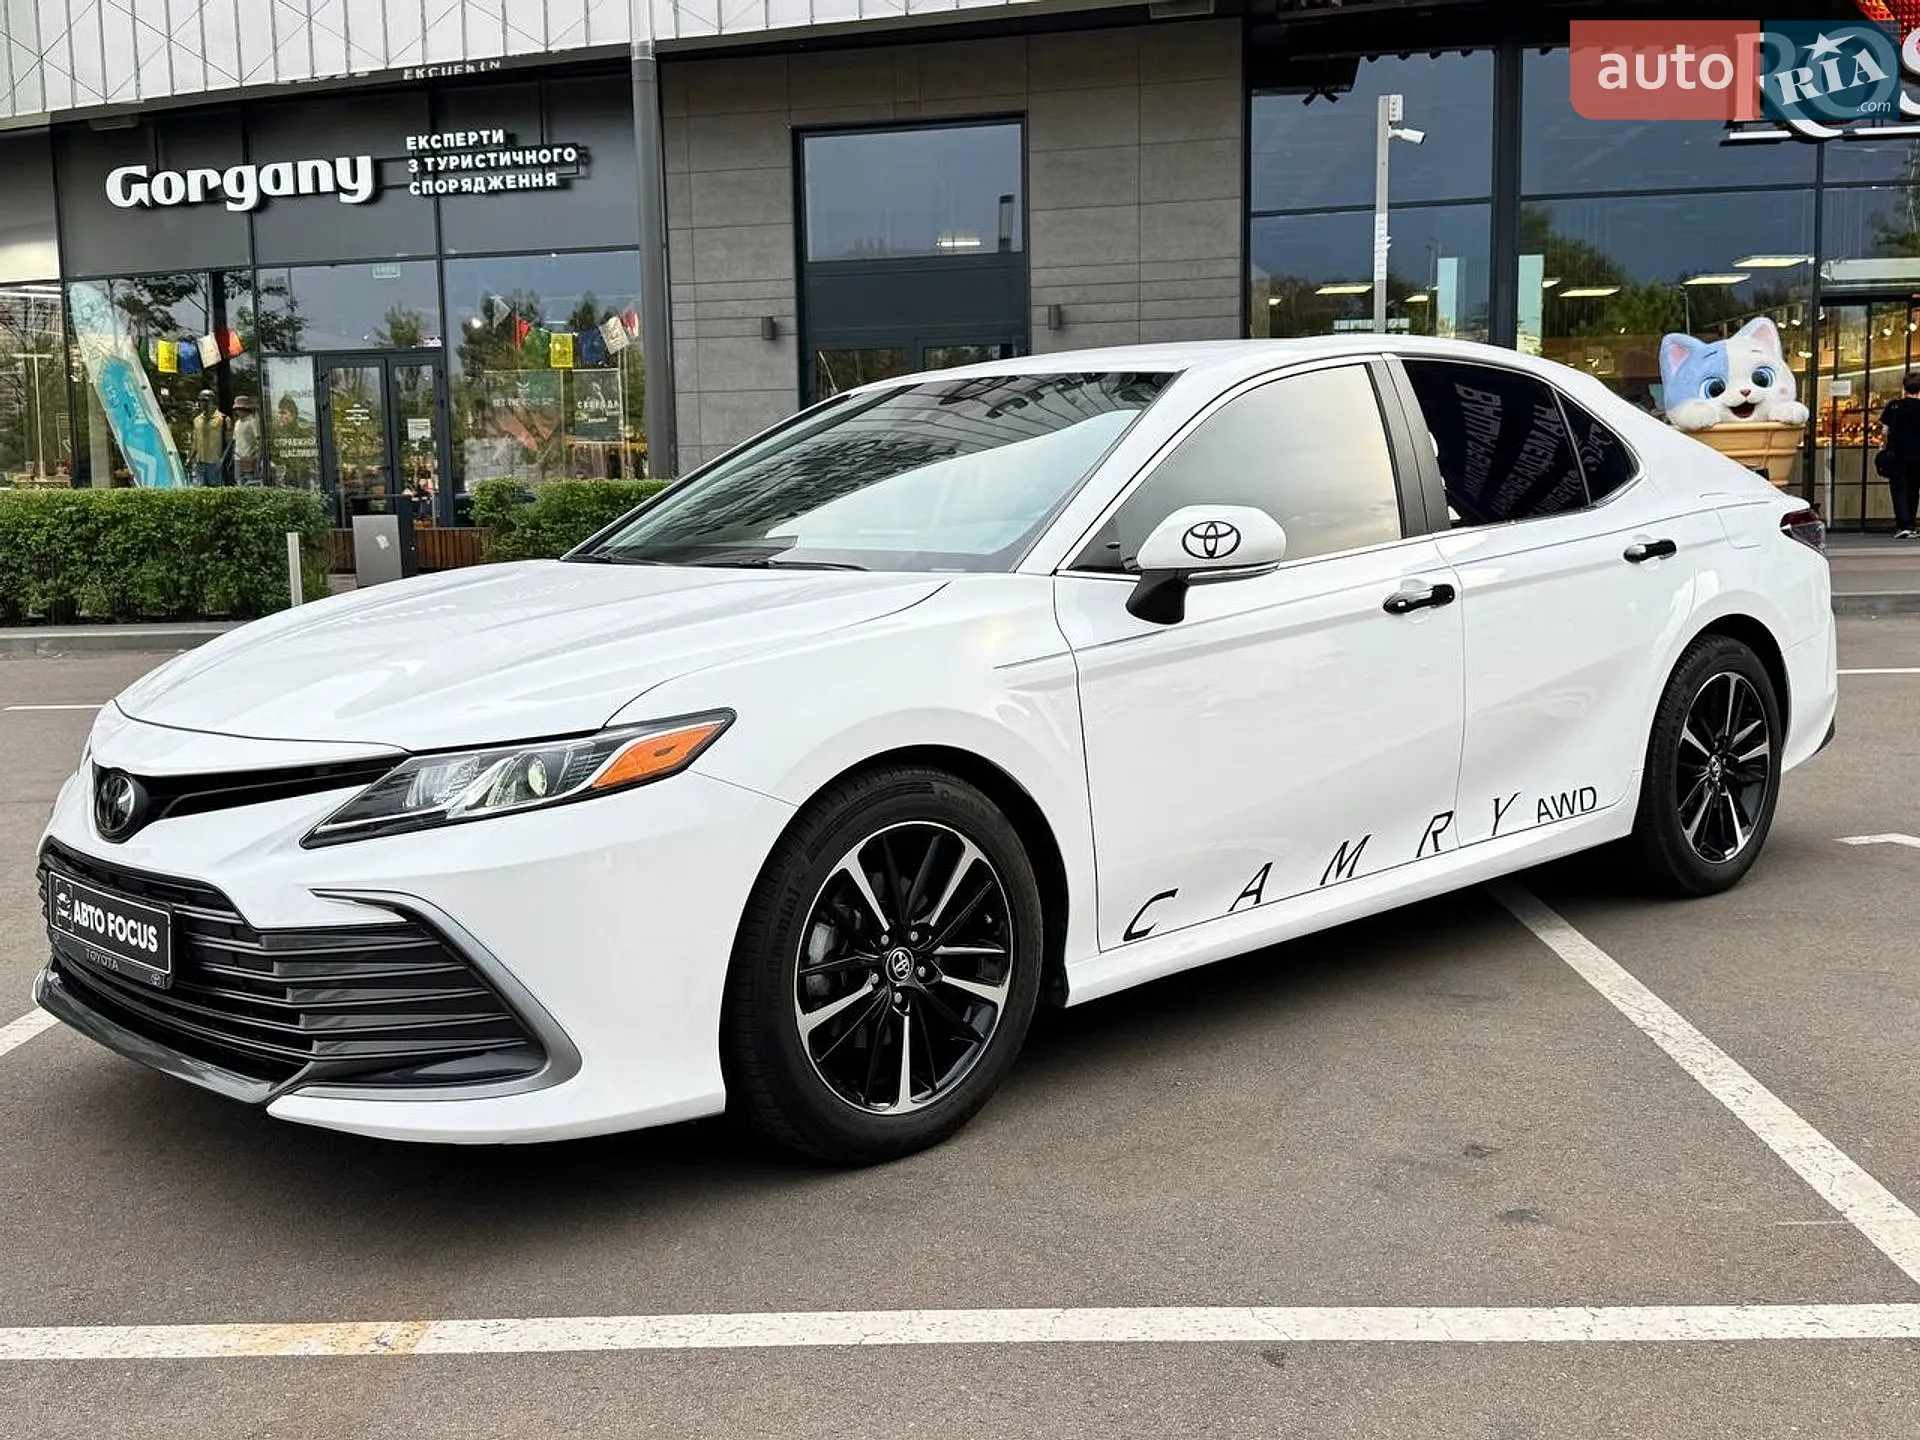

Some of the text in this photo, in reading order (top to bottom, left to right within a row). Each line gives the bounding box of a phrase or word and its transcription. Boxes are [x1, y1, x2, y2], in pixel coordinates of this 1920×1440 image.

[406, 129, 504, 150] ЕКСПЕРТИ
[424, 147, 577, 172] ТУРИСТИЧНОГО
[106, 155, 372, 212] Gorgany
[409, 172, 558, 195] СПОРЯДЖЕННЯ
[1536, 786, 1598, 823] AWD
[73, 900, 158, 953] АВТО FOCUS
